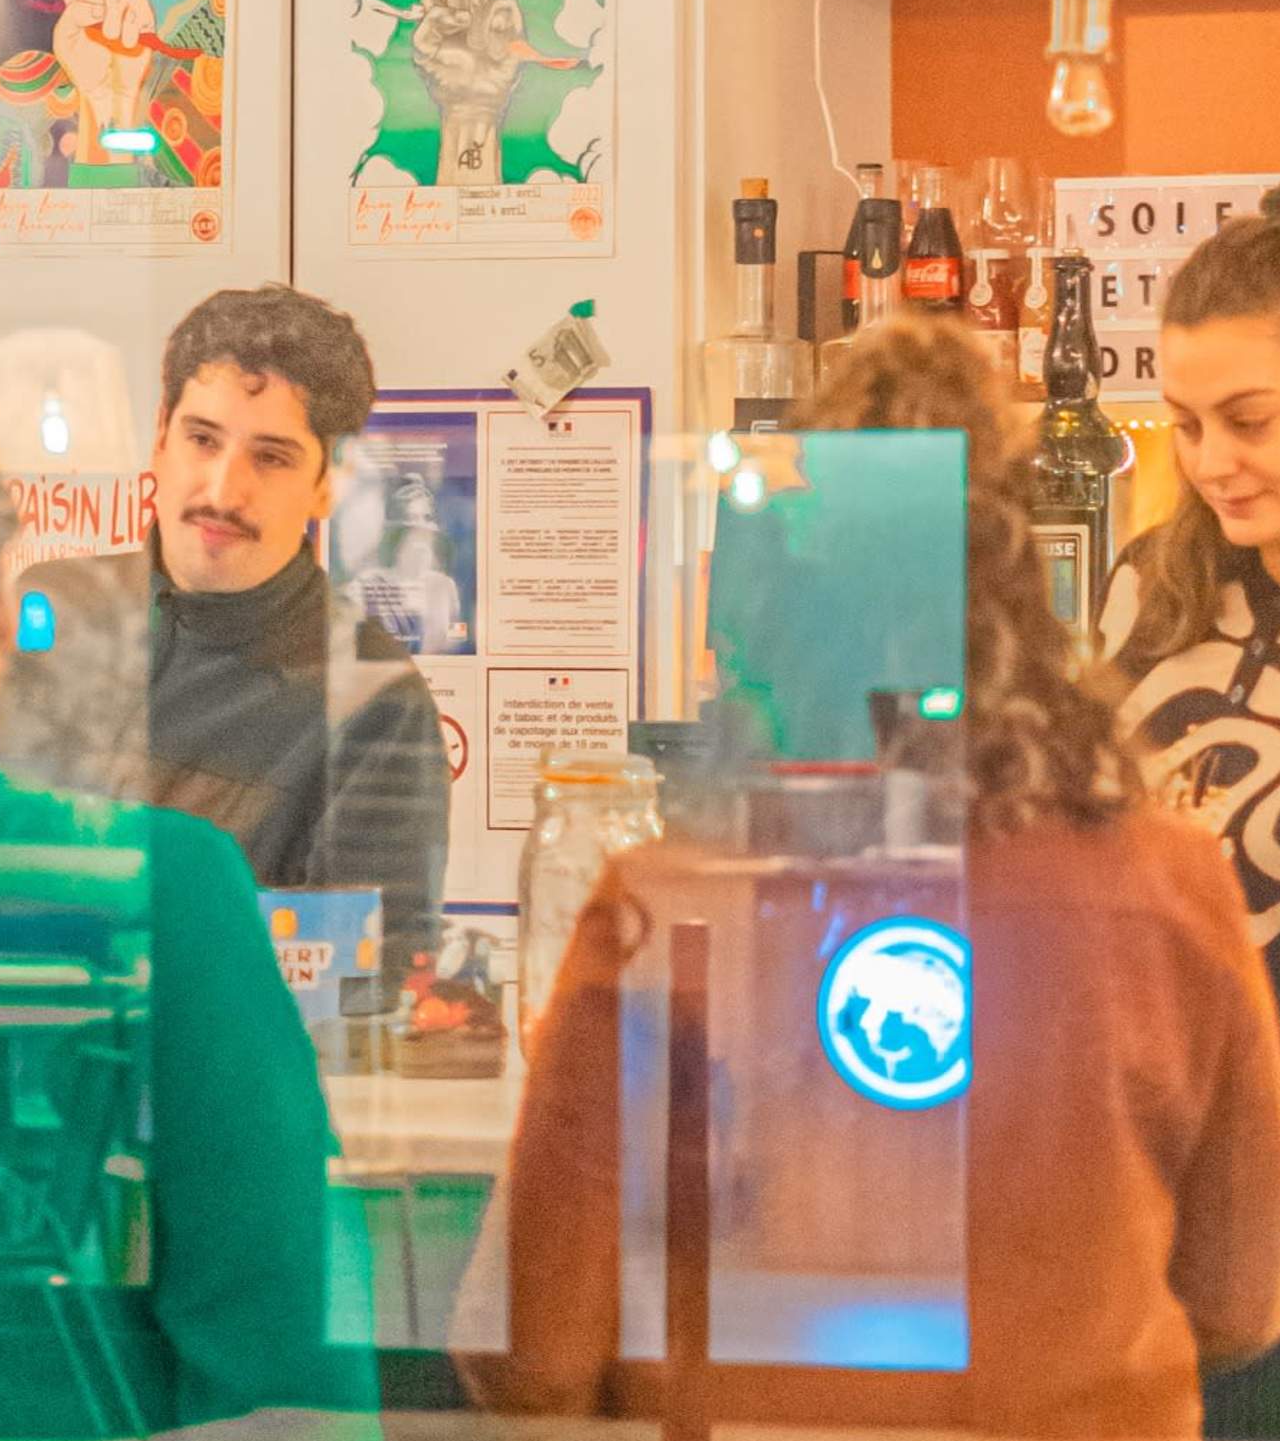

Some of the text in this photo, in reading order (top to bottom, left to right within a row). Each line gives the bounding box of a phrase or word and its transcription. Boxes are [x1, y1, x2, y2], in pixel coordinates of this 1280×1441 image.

[503, 699, 614, 710] Interdiction de vente
[498, 713, 511, 722] de
[514, 713, 544, 722] tabac
[560, 713, 573, 722] de
